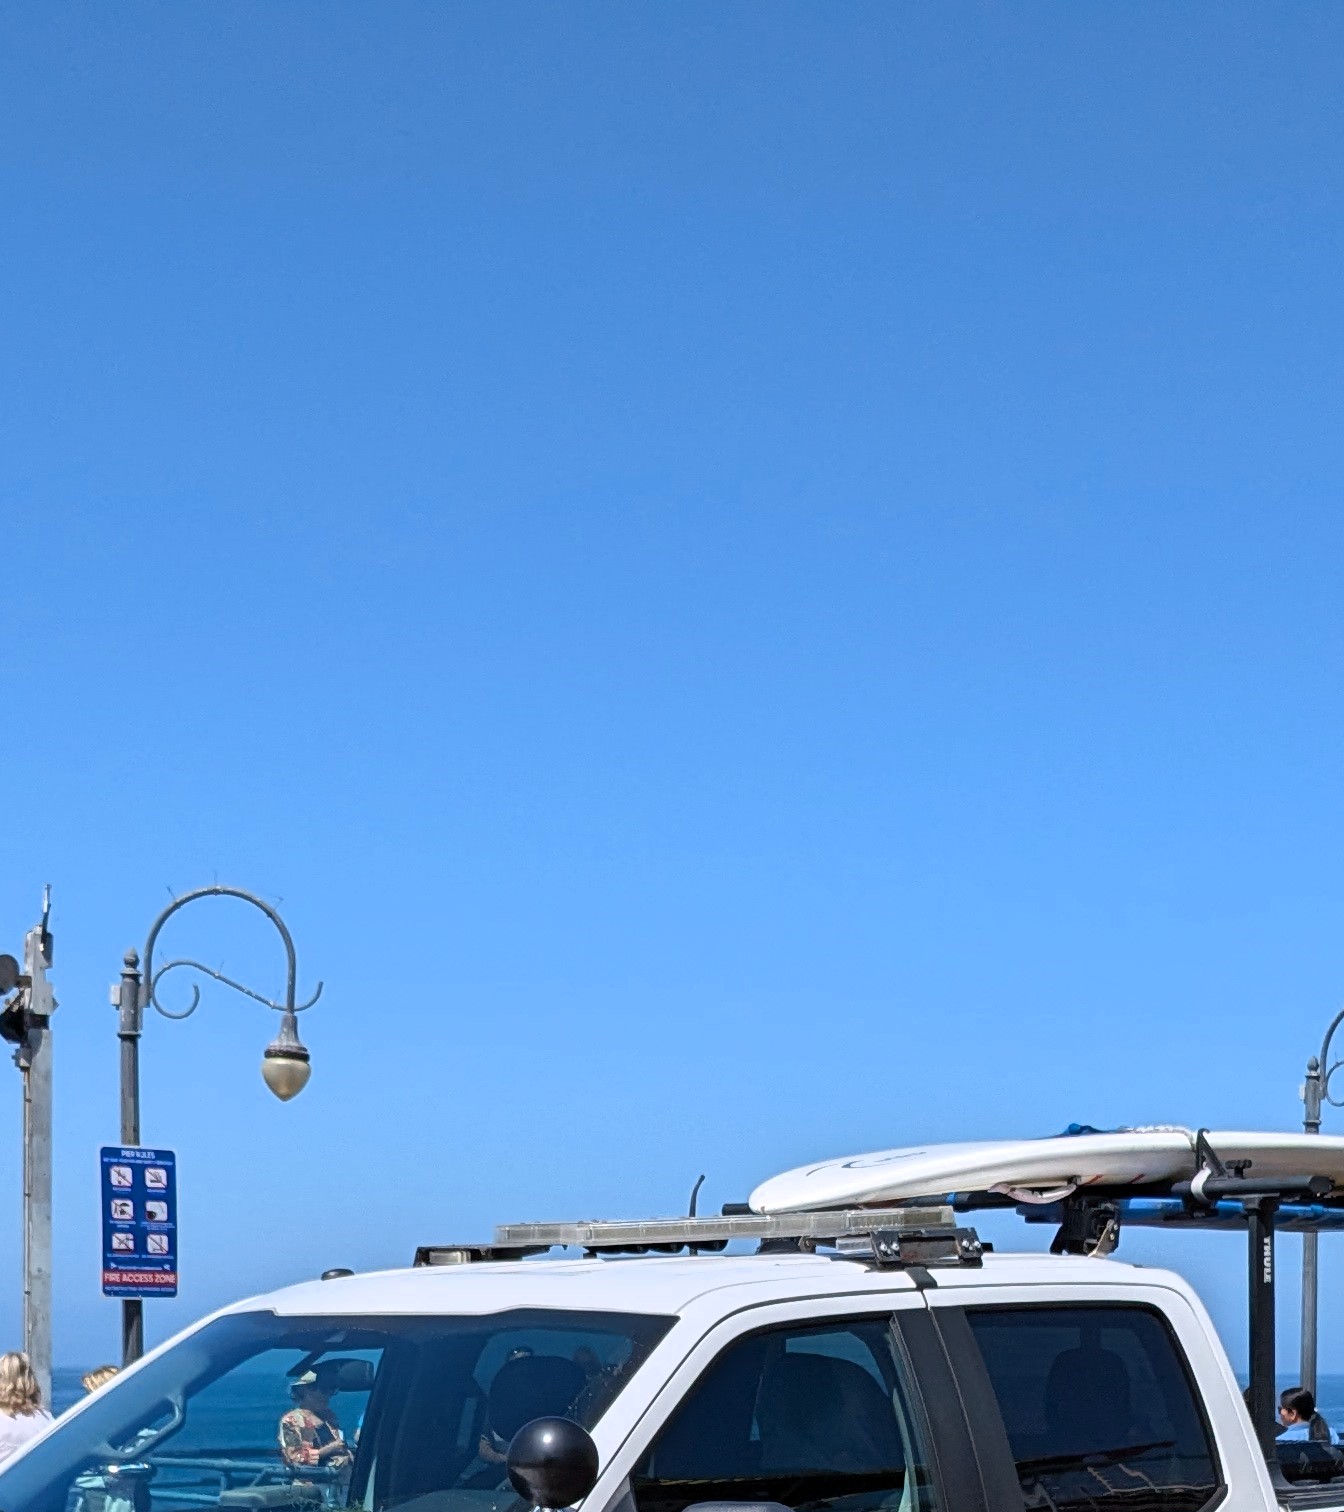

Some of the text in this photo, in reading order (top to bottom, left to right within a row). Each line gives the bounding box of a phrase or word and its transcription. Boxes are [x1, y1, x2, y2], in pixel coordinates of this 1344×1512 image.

[1263, 1236, 1272, 1284] THULE
[104, 1273, 176, 1284] FIRE ACCESS ZONE
